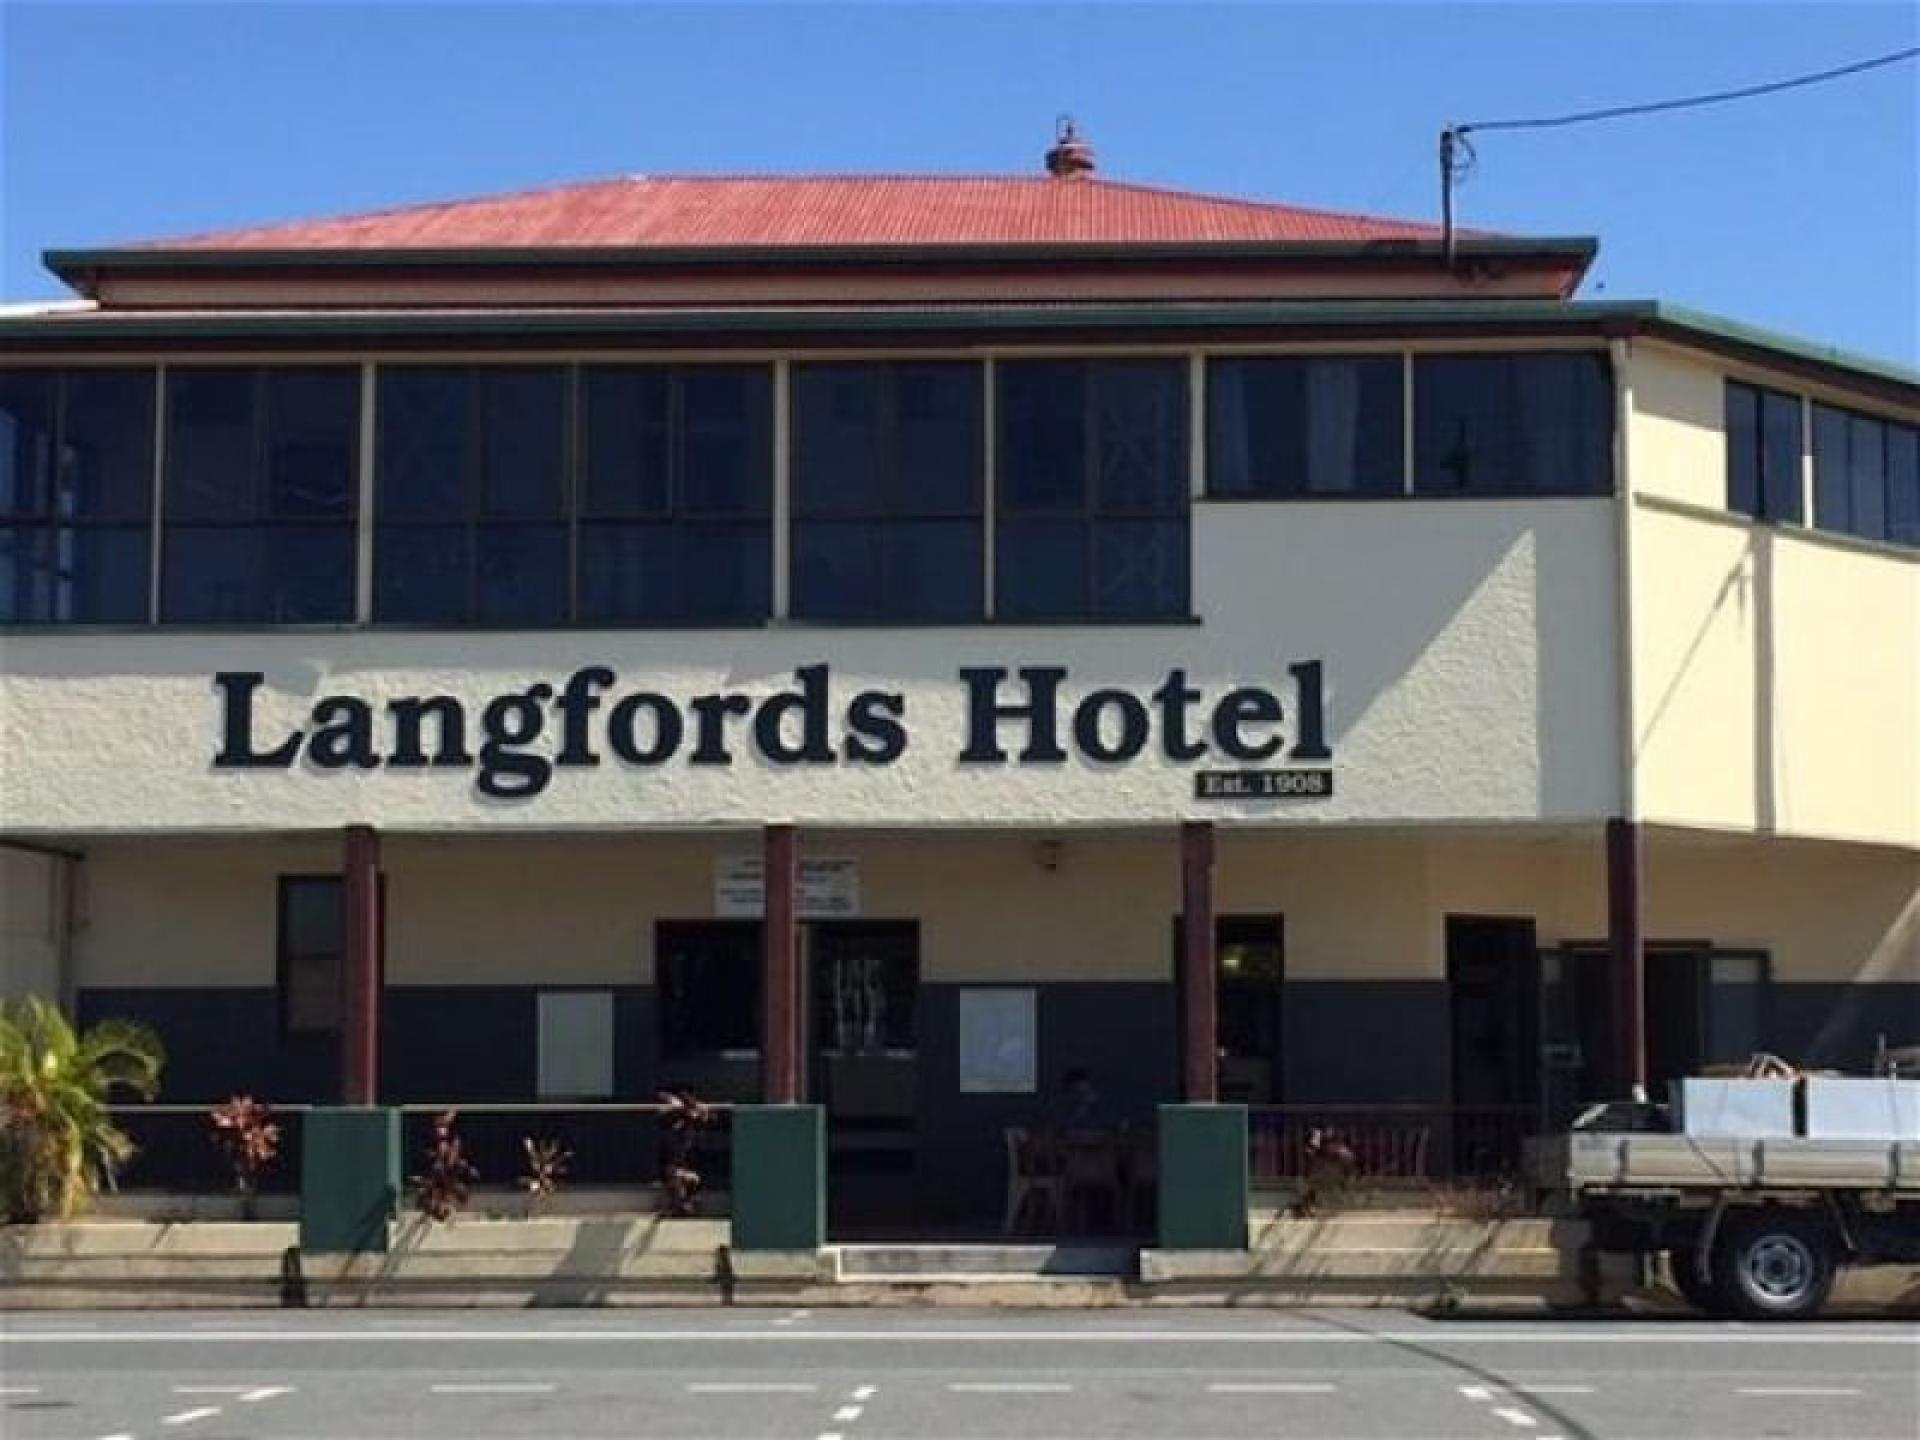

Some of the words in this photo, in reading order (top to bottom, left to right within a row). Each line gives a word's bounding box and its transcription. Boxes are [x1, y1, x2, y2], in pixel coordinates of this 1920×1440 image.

[213, 664, 907, 797] Langfords
[959, 660, 1333, 763] Hotel
[1204, 773, 1251, 794] Est.
[1263, 773, 1324, 794] 1908
